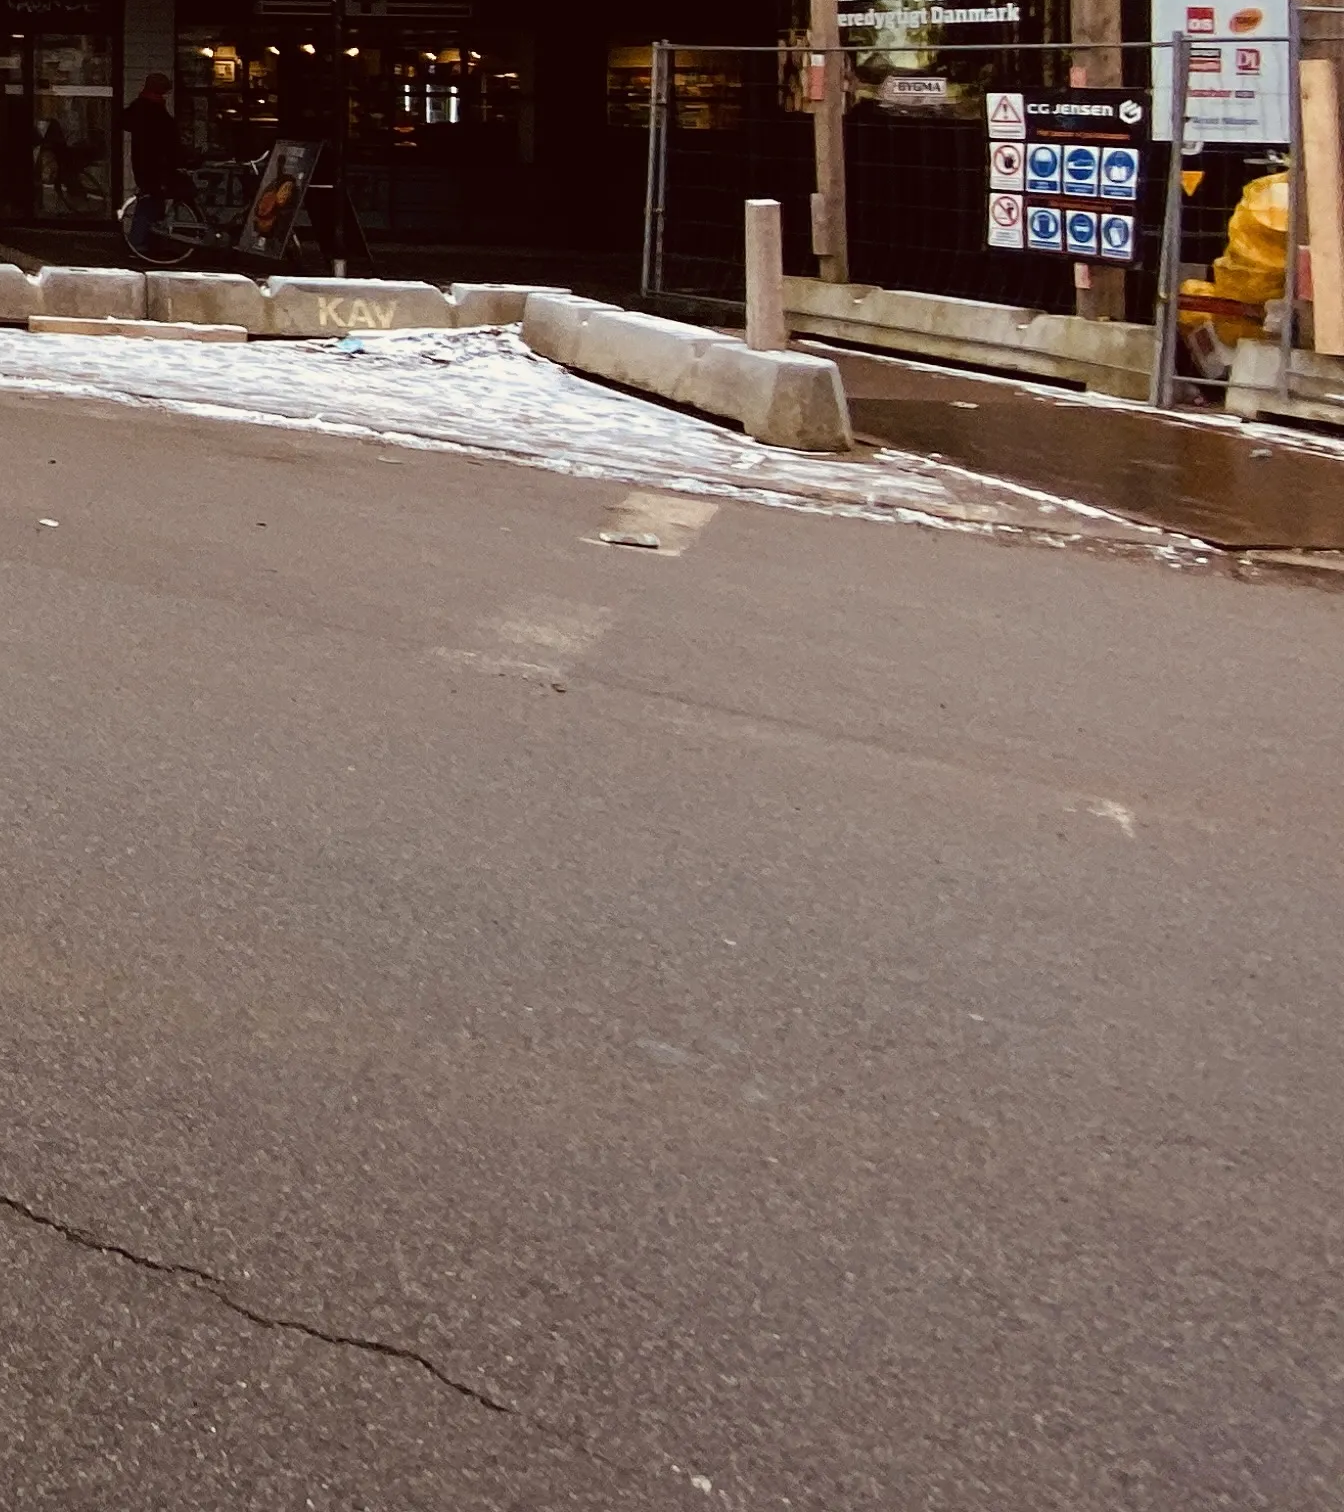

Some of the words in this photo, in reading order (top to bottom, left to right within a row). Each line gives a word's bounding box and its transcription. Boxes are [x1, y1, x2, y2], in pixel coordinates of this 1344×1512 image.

[931, 2, 1020, 24] Danmark
[1027, 103, 1050, 114] CG
[1052, 104, 1114, 116] JENSEN
